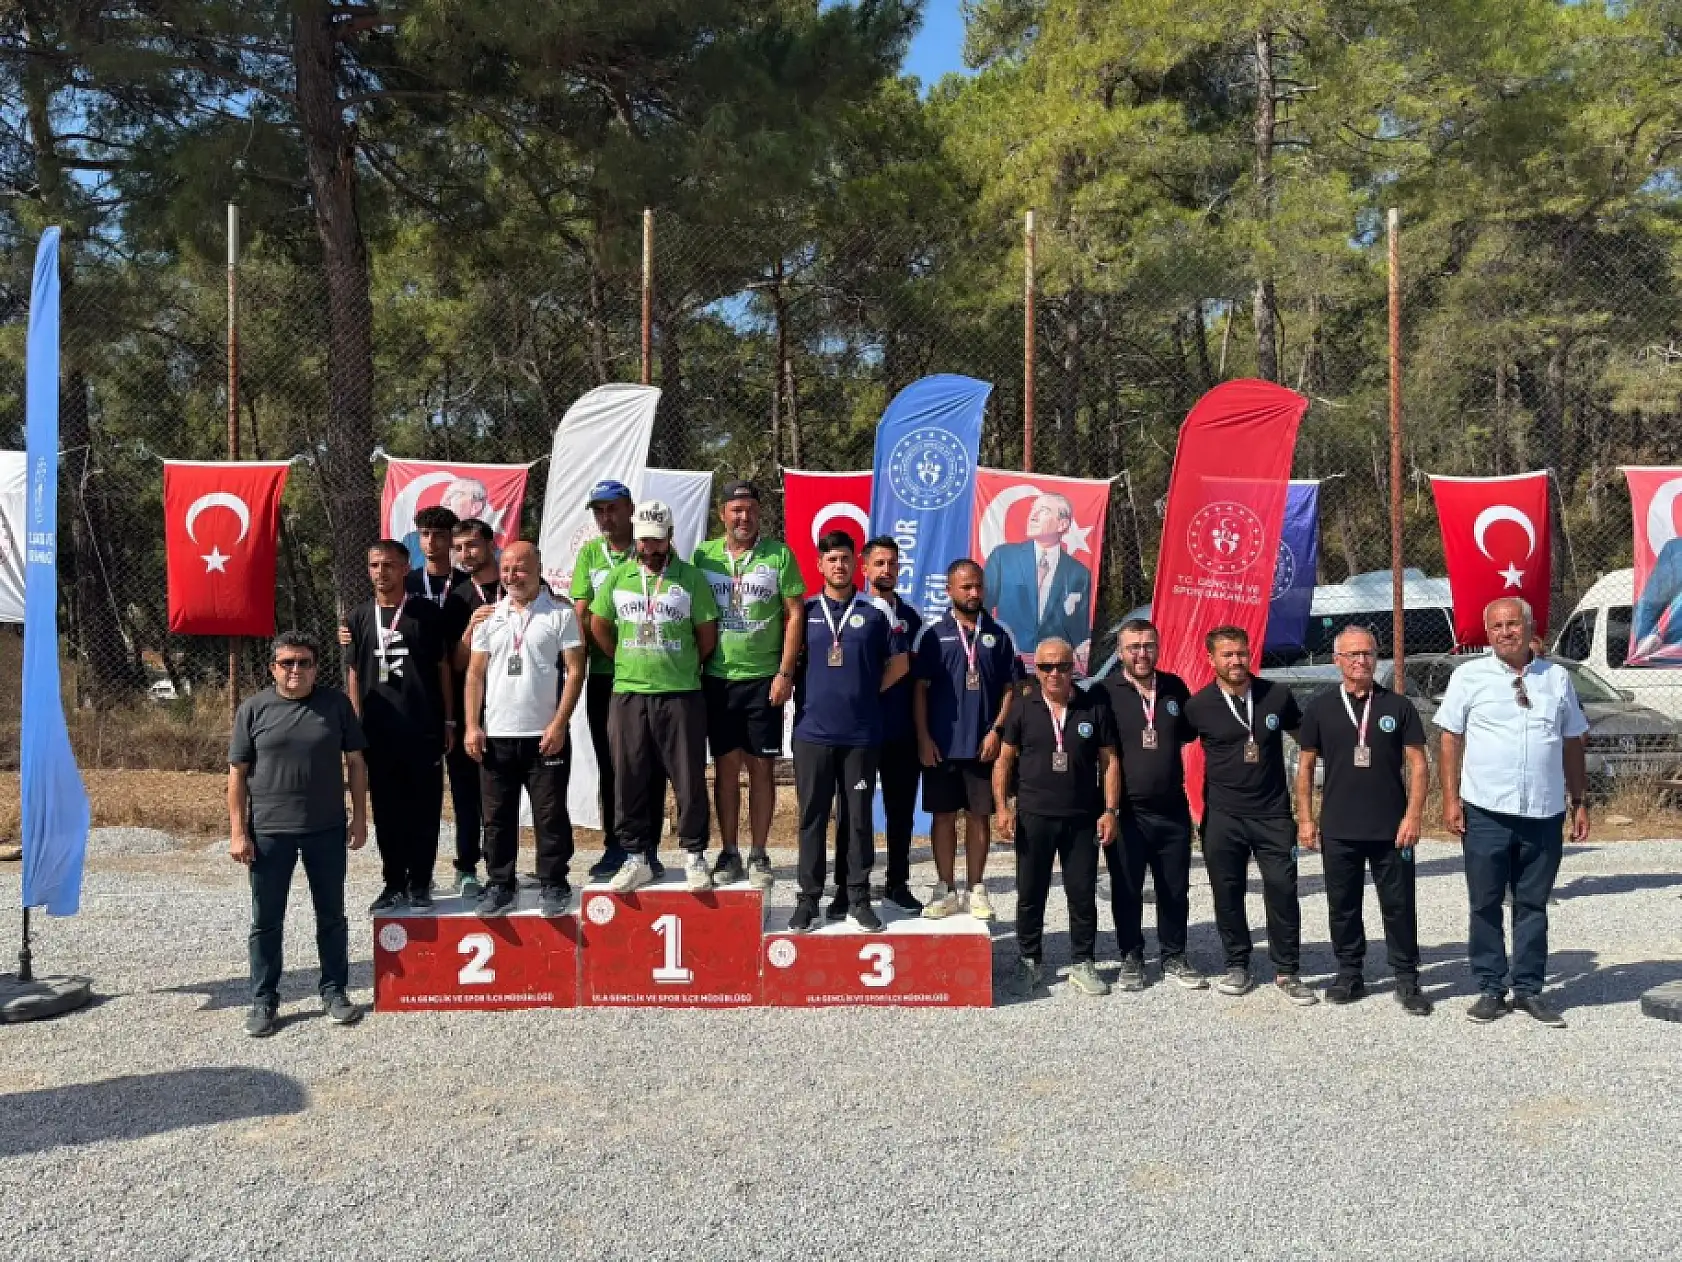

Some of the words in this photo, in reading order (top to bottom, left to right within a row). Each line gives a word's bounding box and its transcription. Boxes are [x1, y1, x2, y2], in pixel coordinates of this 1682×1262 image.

[457, 932, 496, 985] 2
[651, 914, 692, 985] 1
[858, 943, 895, 987] 3
